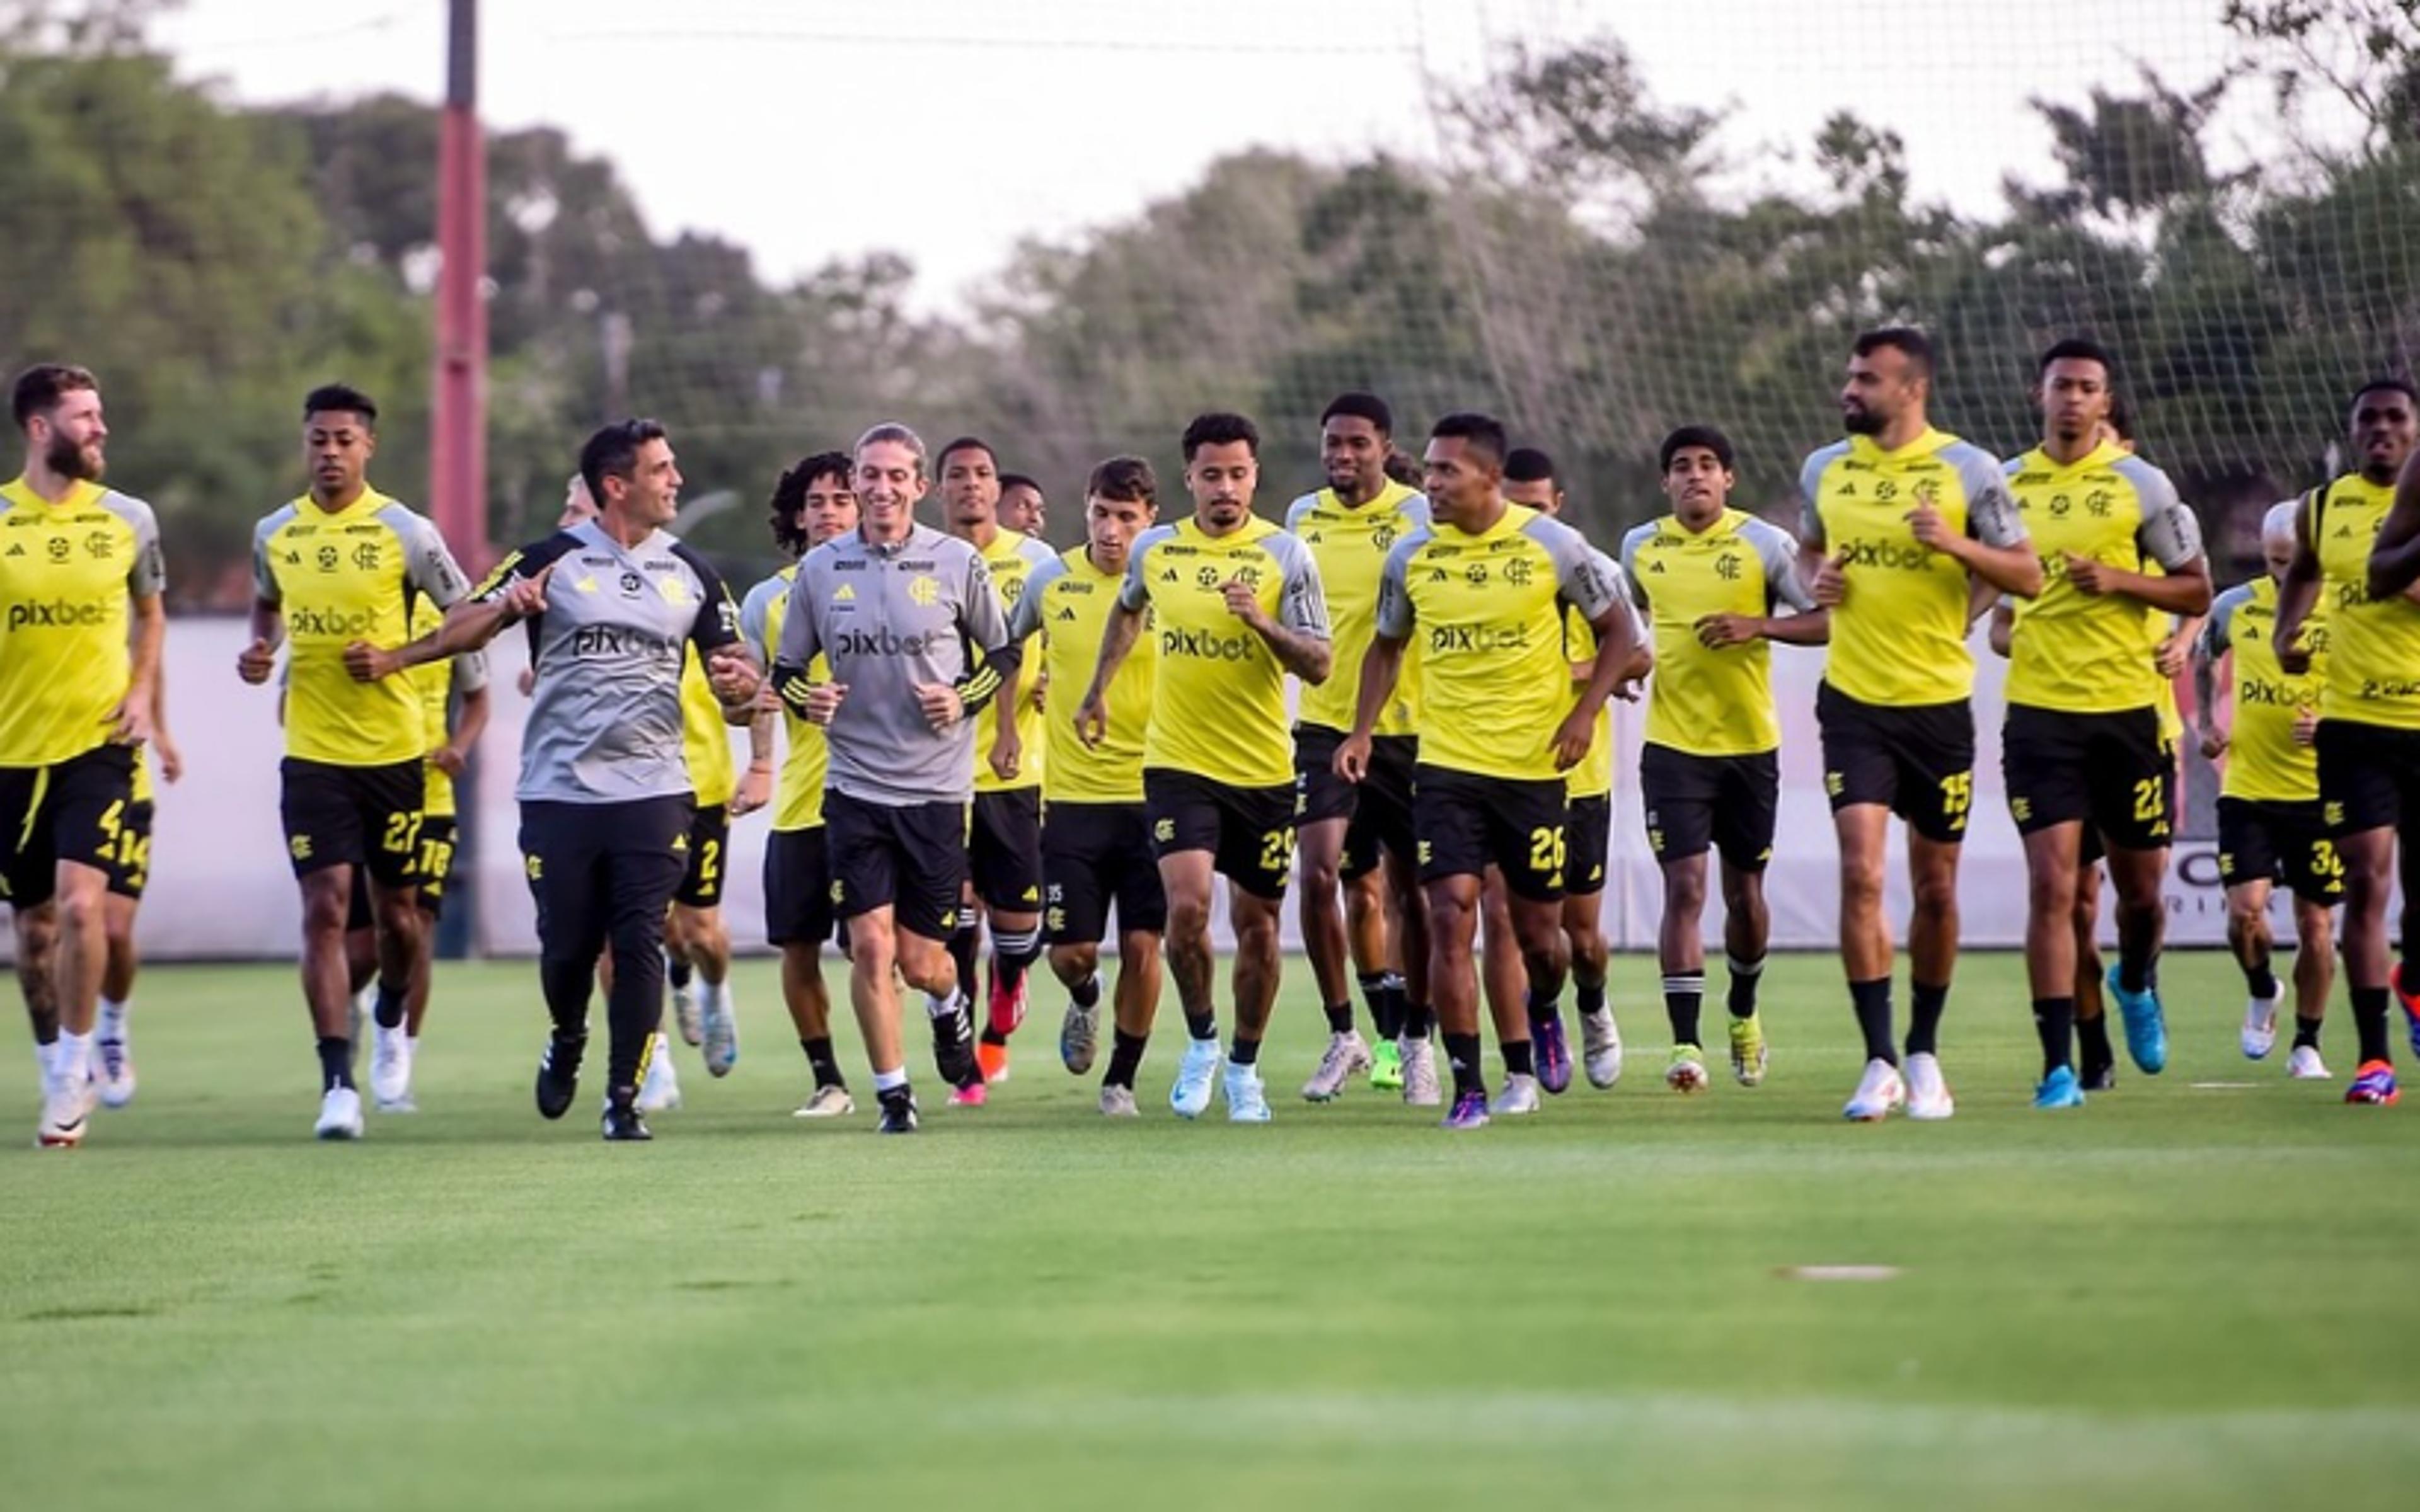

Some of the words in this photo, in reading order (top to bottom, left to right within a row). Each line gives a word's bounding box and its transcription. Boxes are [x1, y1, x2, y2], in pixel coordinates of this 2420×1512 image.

[9, 597, 106, 633] pixbet
[291, 605, 380, 638] pixbet
[572, 624, 682, 656] pixbet
[835, 625, 937, 662] pixbet
[1162, 627, 1254, 661] pixbet
[1432, 622, 1530, 653] pixbet
[2241, 678, 2324, 706] pixbet
[1939, 770, 1971, 815] 15
[99, 799, 125, 840] 4
[383, 811, 424, 854] 27
[118, 829, 151, 870] 14
[420, 839, 453, 878] 18
[701, 839, 719, 879] 2
[1530, 826, 1566, 869] 26
